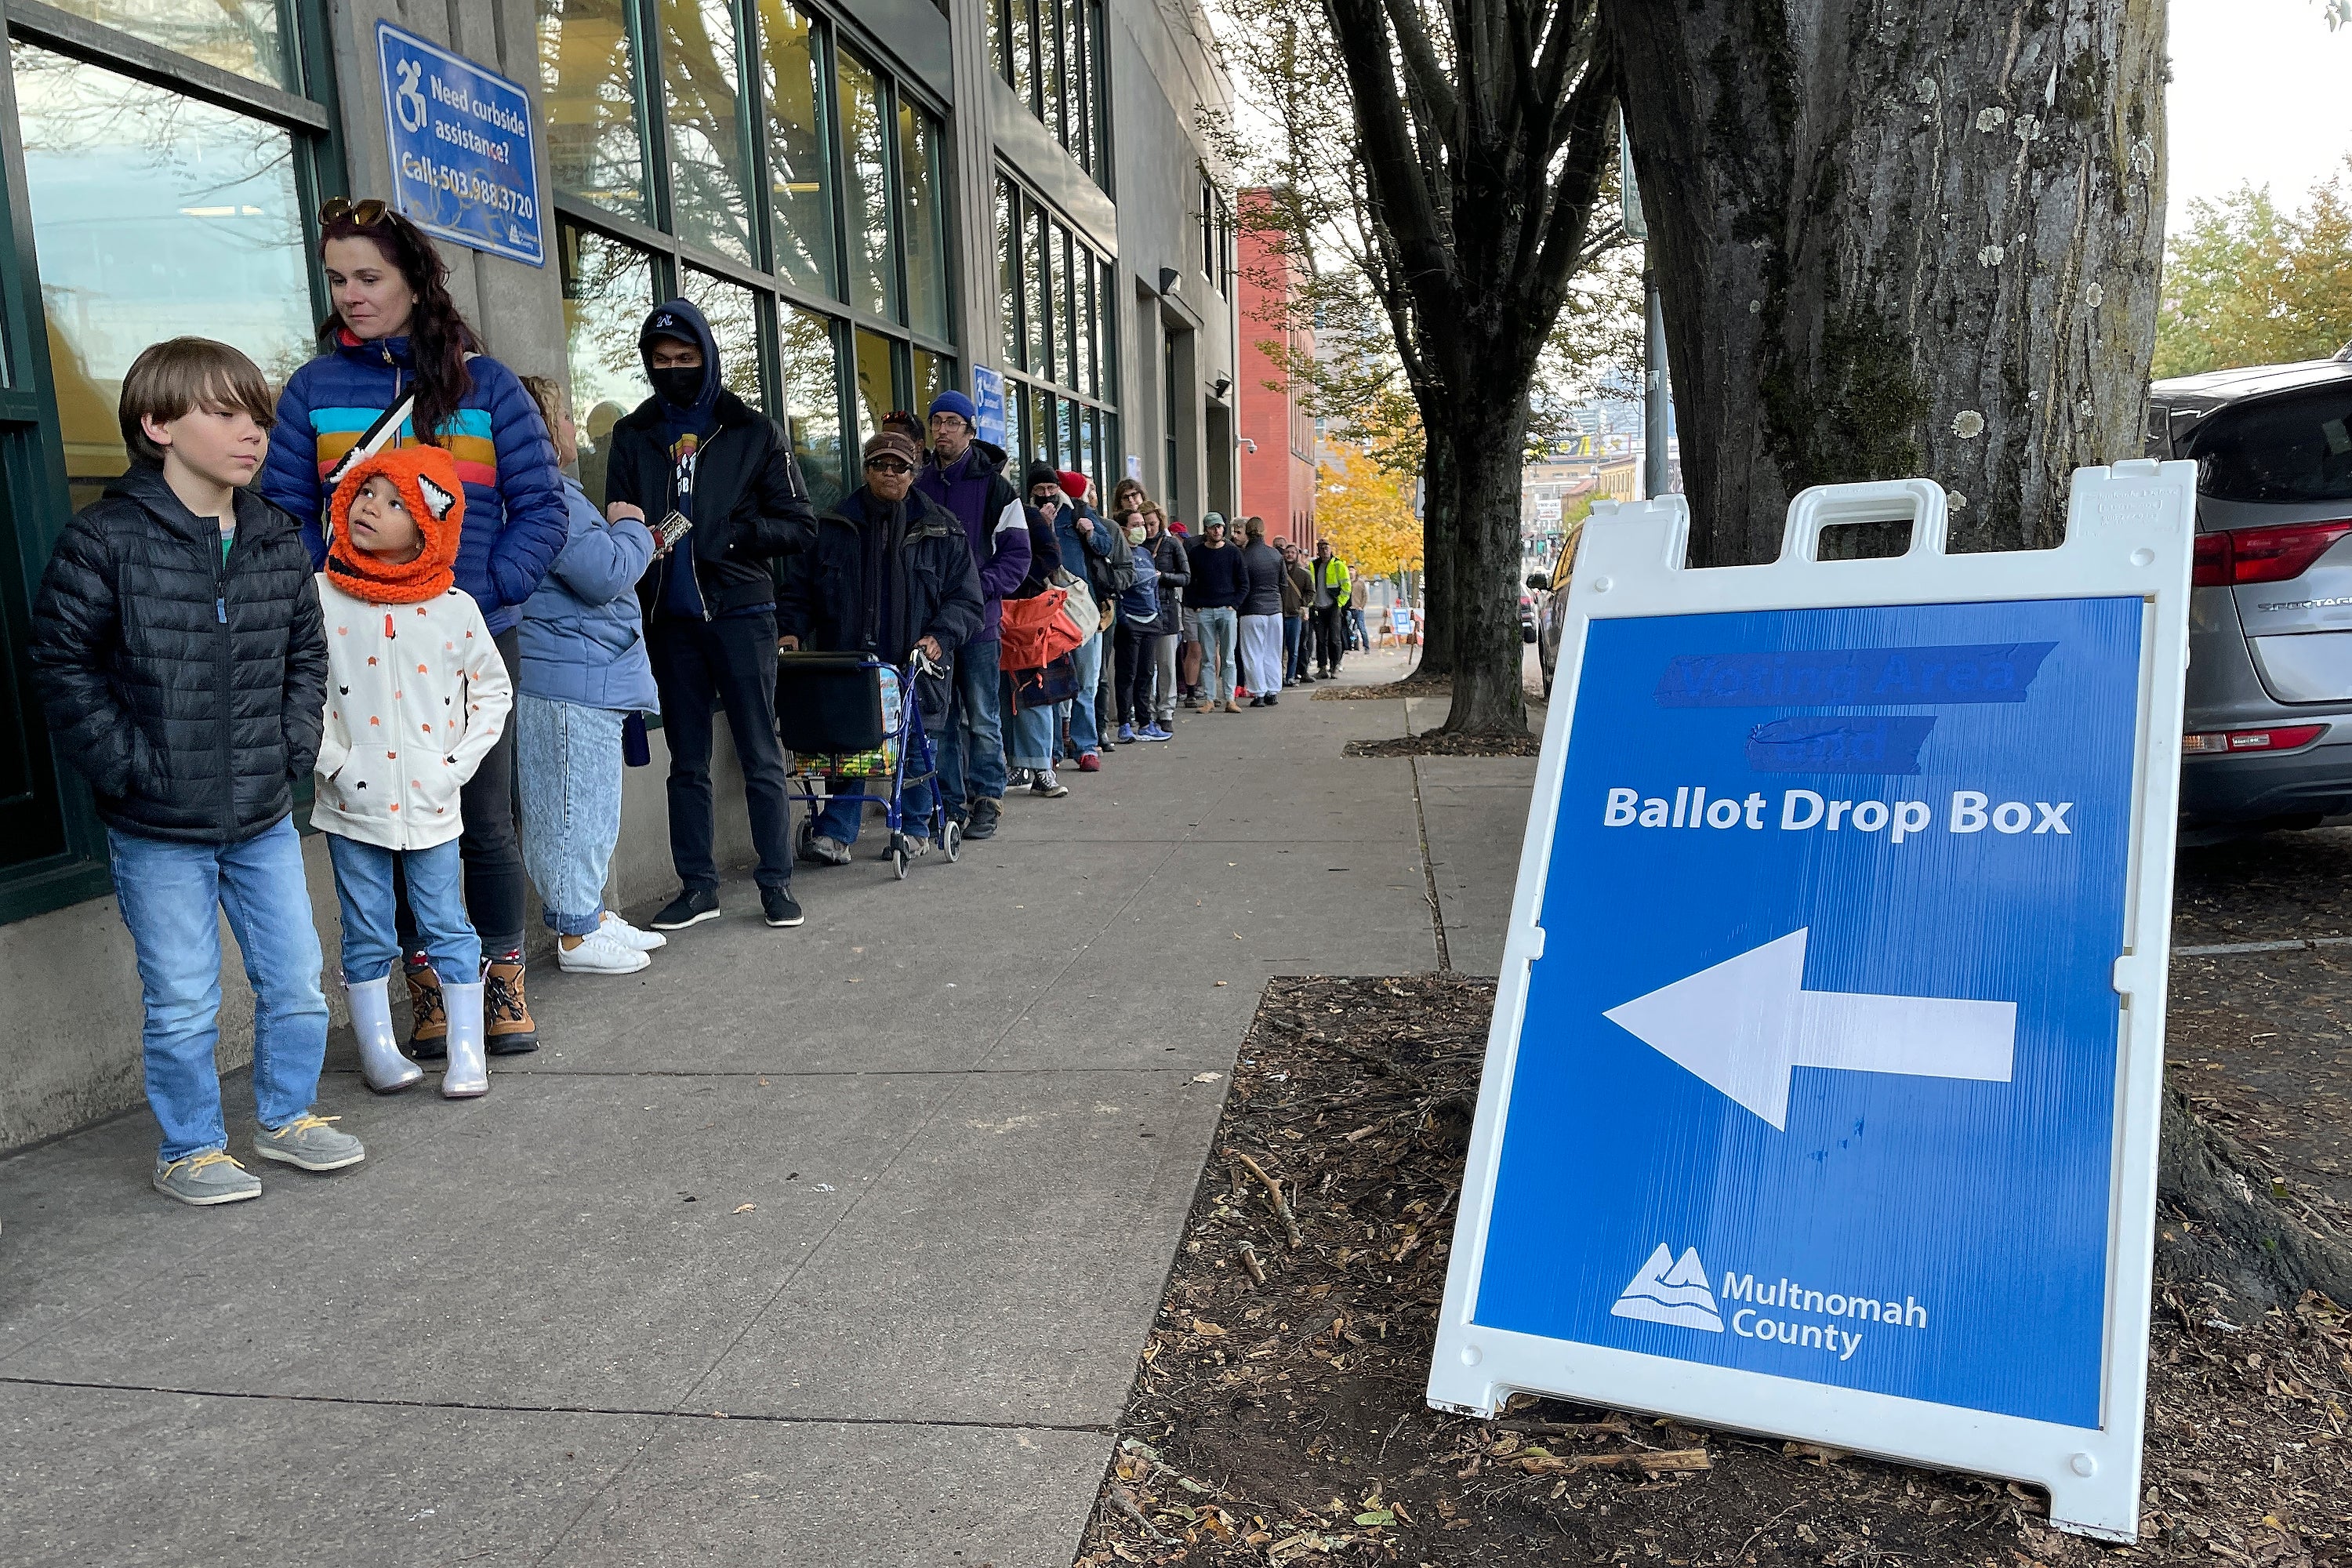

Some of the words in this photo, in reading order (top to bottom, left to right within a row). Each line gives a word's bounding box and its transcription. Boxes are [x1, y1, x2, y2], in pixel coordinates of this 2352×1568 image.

[430, 74, 469, 113] Need
[472, 100, 526, 138] curbside
[435, 119, 510, 164] assistance?
[402, 151, 437, 187] Call:
[440, 165, 533, 220] 503.988.3720
[1604, 786, 1766, 830] Ballot
[1780, 789, 1932, 844] Drop
[1950, 789, 2073, 835] Box
[1722, 1271, 1928, 1329] Multnomah
[1733, 1308, 1863, 1362] County
